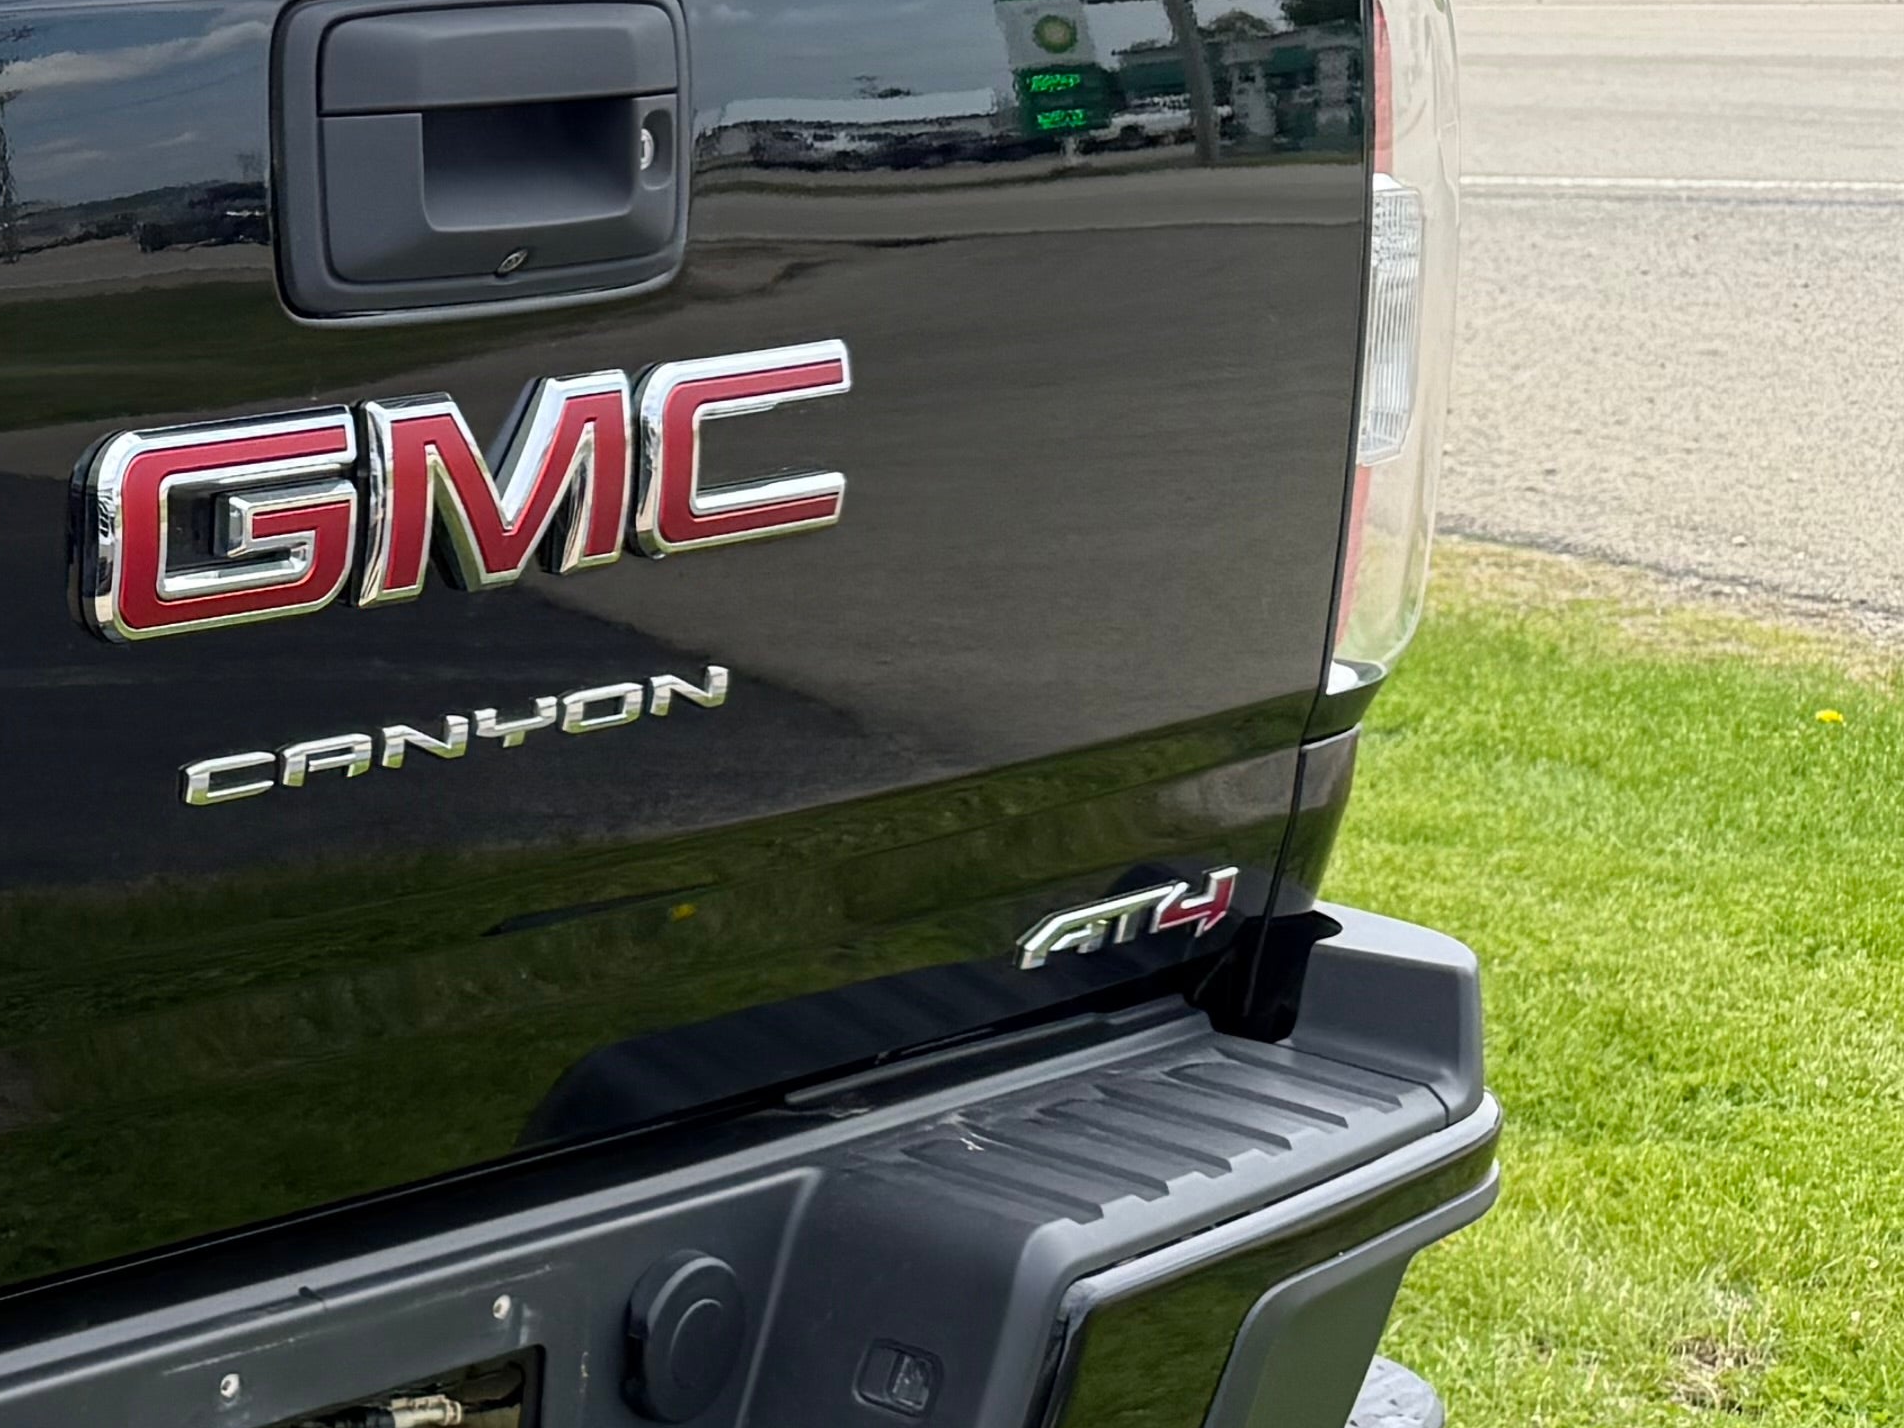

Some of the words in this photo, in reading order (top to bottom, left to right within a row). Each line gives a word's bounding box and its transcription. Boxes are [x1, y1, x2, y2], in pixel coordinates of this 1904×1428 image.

[69, 338, 852, 643] GMC
[179, 664, 730, 808] CANYON
[1014, 865, 1240, 970] AT4
